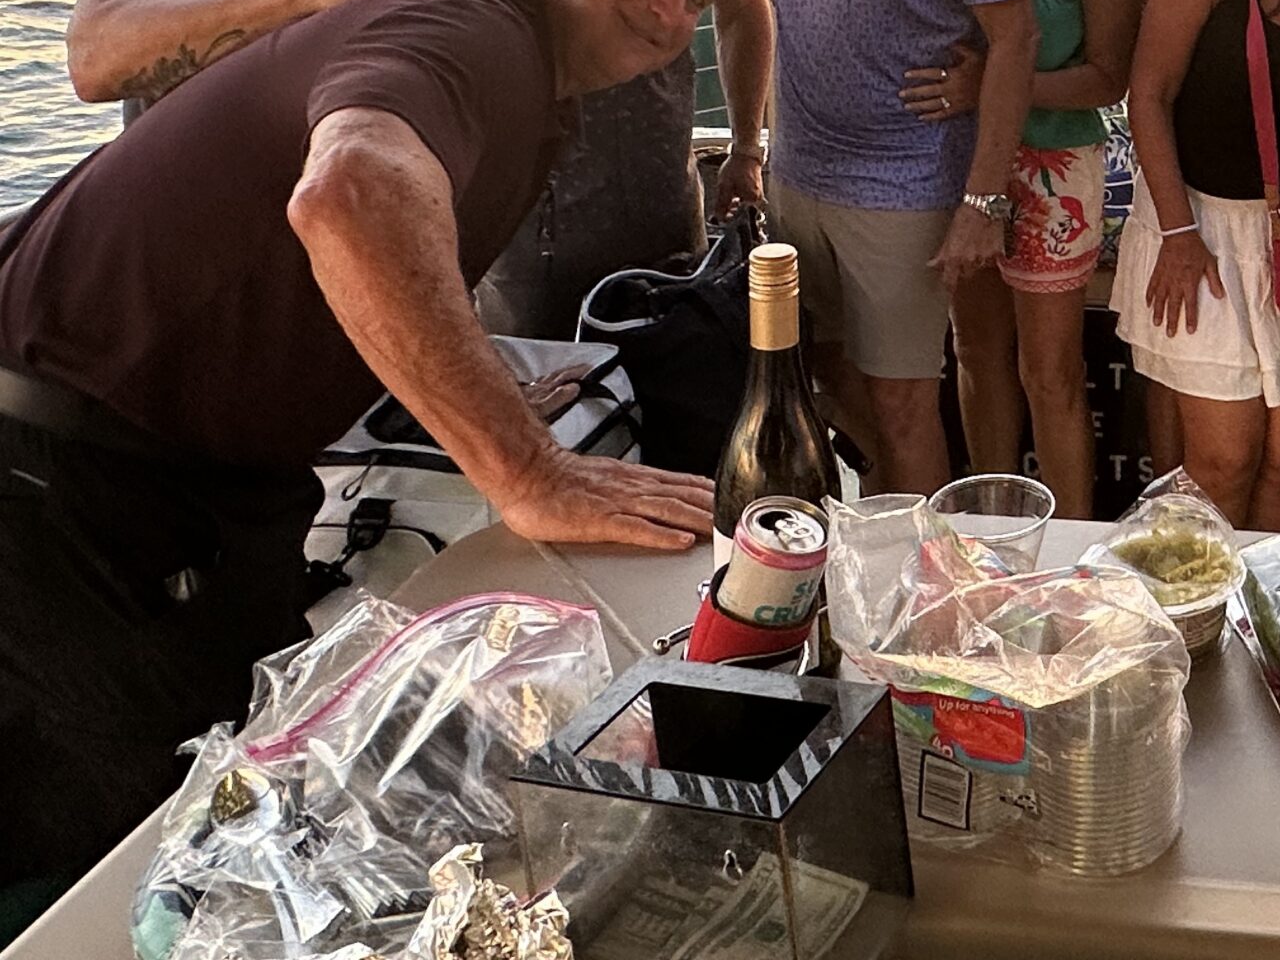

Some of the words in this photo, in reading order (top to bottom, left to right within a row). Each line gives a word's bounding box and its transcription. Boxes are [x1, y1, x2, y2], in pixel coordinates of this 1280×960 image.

[939, 699, 954, 712] Up
[956, 700, 970, 711] for
[971, 703, 1015, 719] anything
